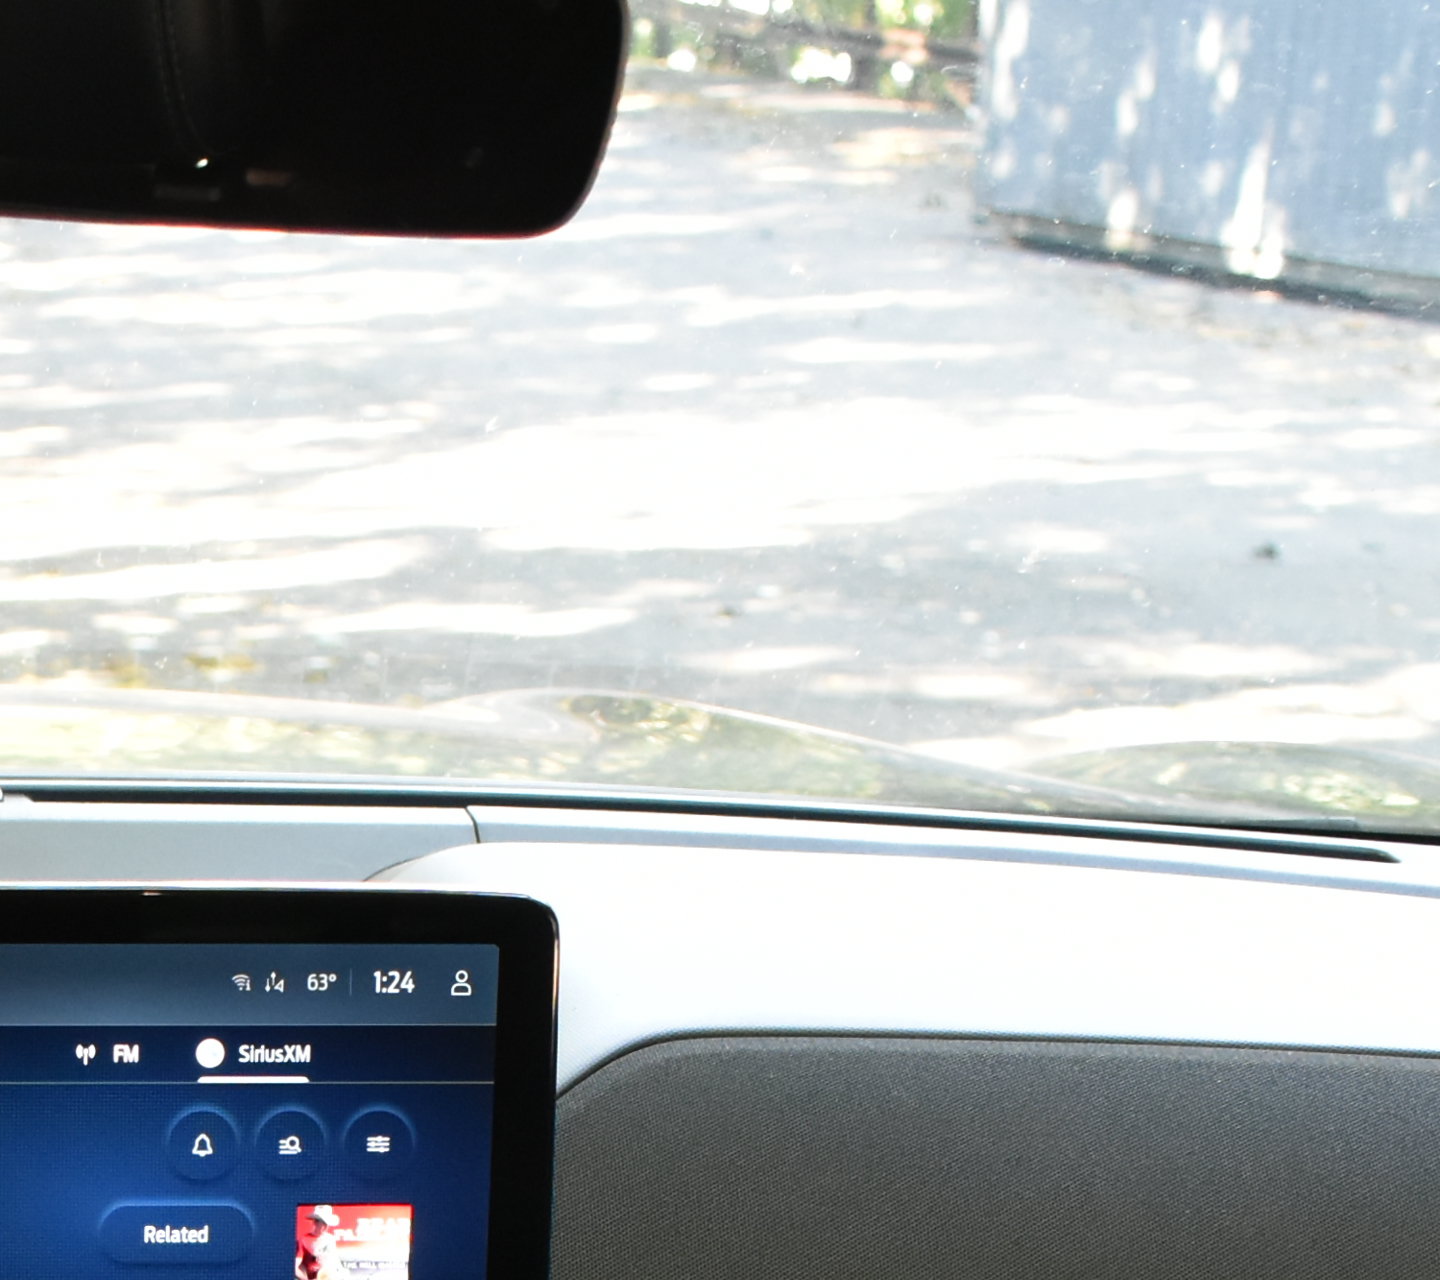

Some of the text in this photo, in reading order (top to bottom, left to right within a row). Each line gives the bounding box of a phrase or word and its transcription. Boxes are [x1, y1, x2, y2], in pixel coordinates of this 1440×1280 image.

[306, 970, 415, 994] 63° 1:24
[113, 1044, 139, 1064] FM
[238, 1043, 312, 1064] SiriusXM
[143, 1226, 209, 1244] Related
